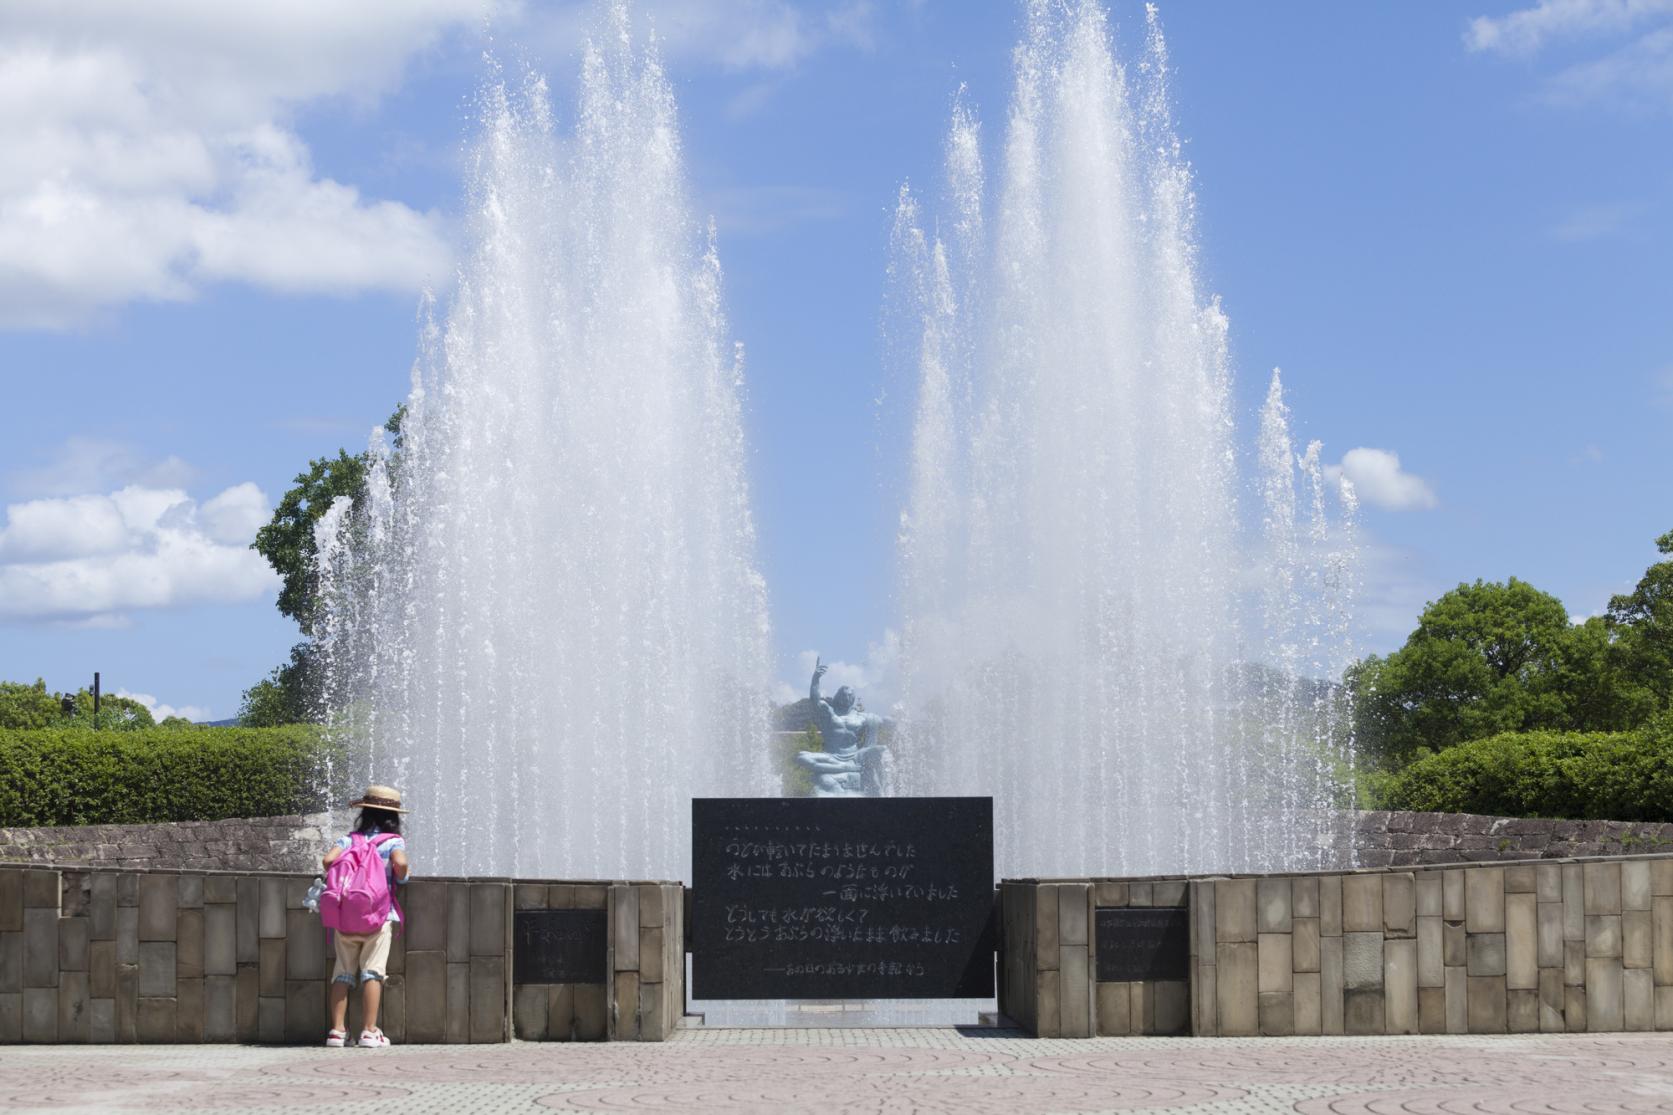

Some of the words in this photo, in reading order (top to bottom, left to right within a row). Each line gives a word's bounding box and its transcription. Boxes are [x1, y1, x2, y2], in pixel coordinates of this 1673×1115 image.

[822, 882, 959, 902] 一面に浮いていました
[725, 904, 869, 923] どうしても水が欲しくて
